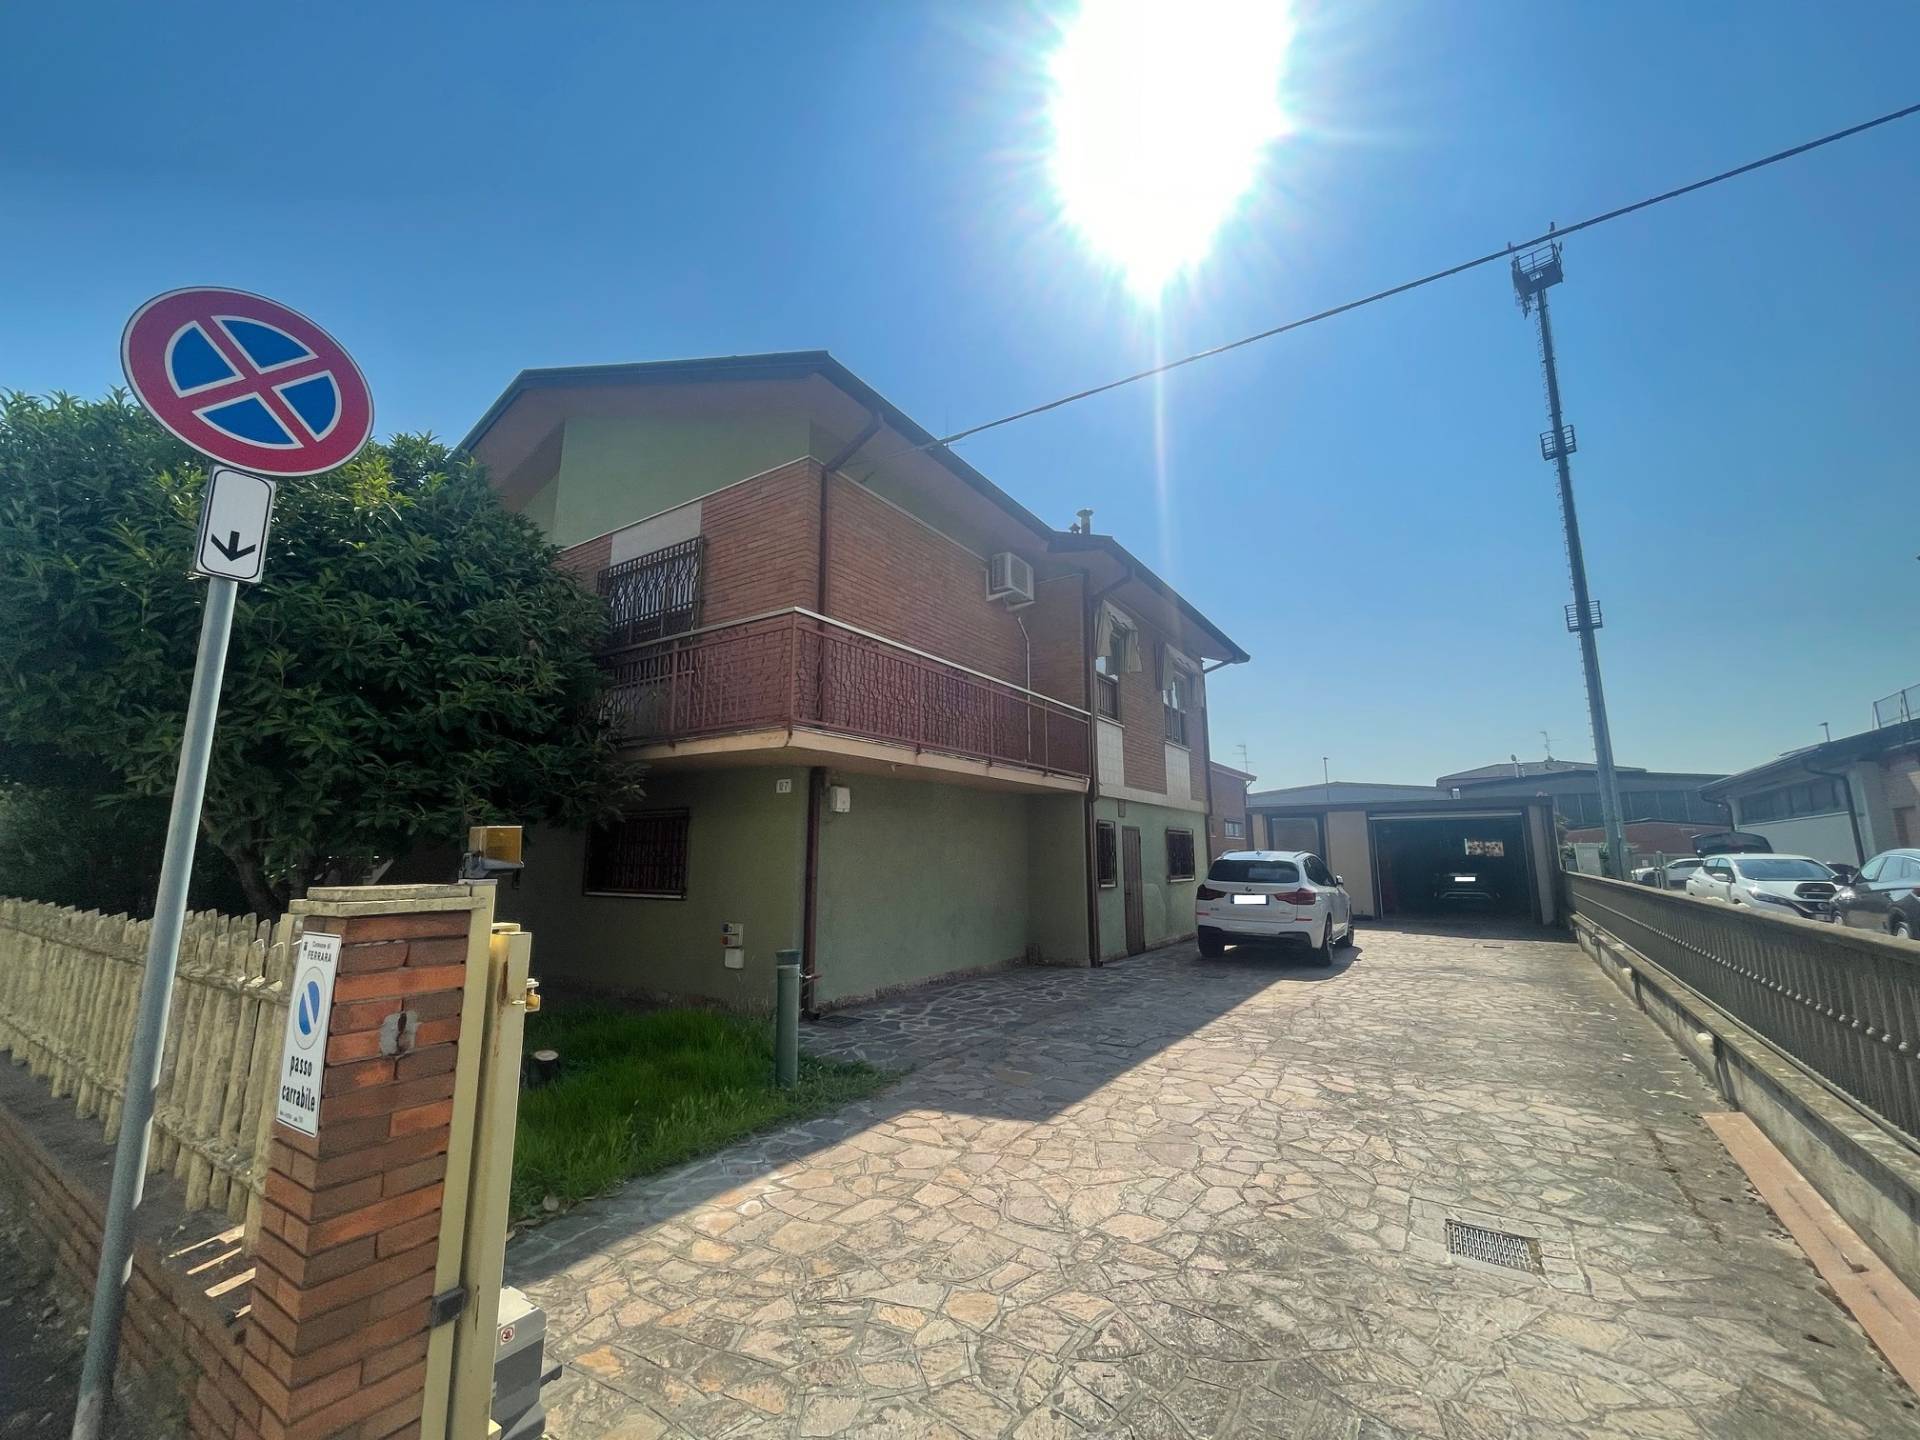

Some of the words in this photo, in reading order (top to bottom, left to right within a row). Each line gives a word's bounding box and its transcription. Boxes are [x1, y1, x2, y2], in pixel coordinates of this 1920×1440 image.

[307, 950, 332, 963] FERRARA
[289, 1056, 312, 1077] passo
[282, 1085, 315, 1112] carrabile
